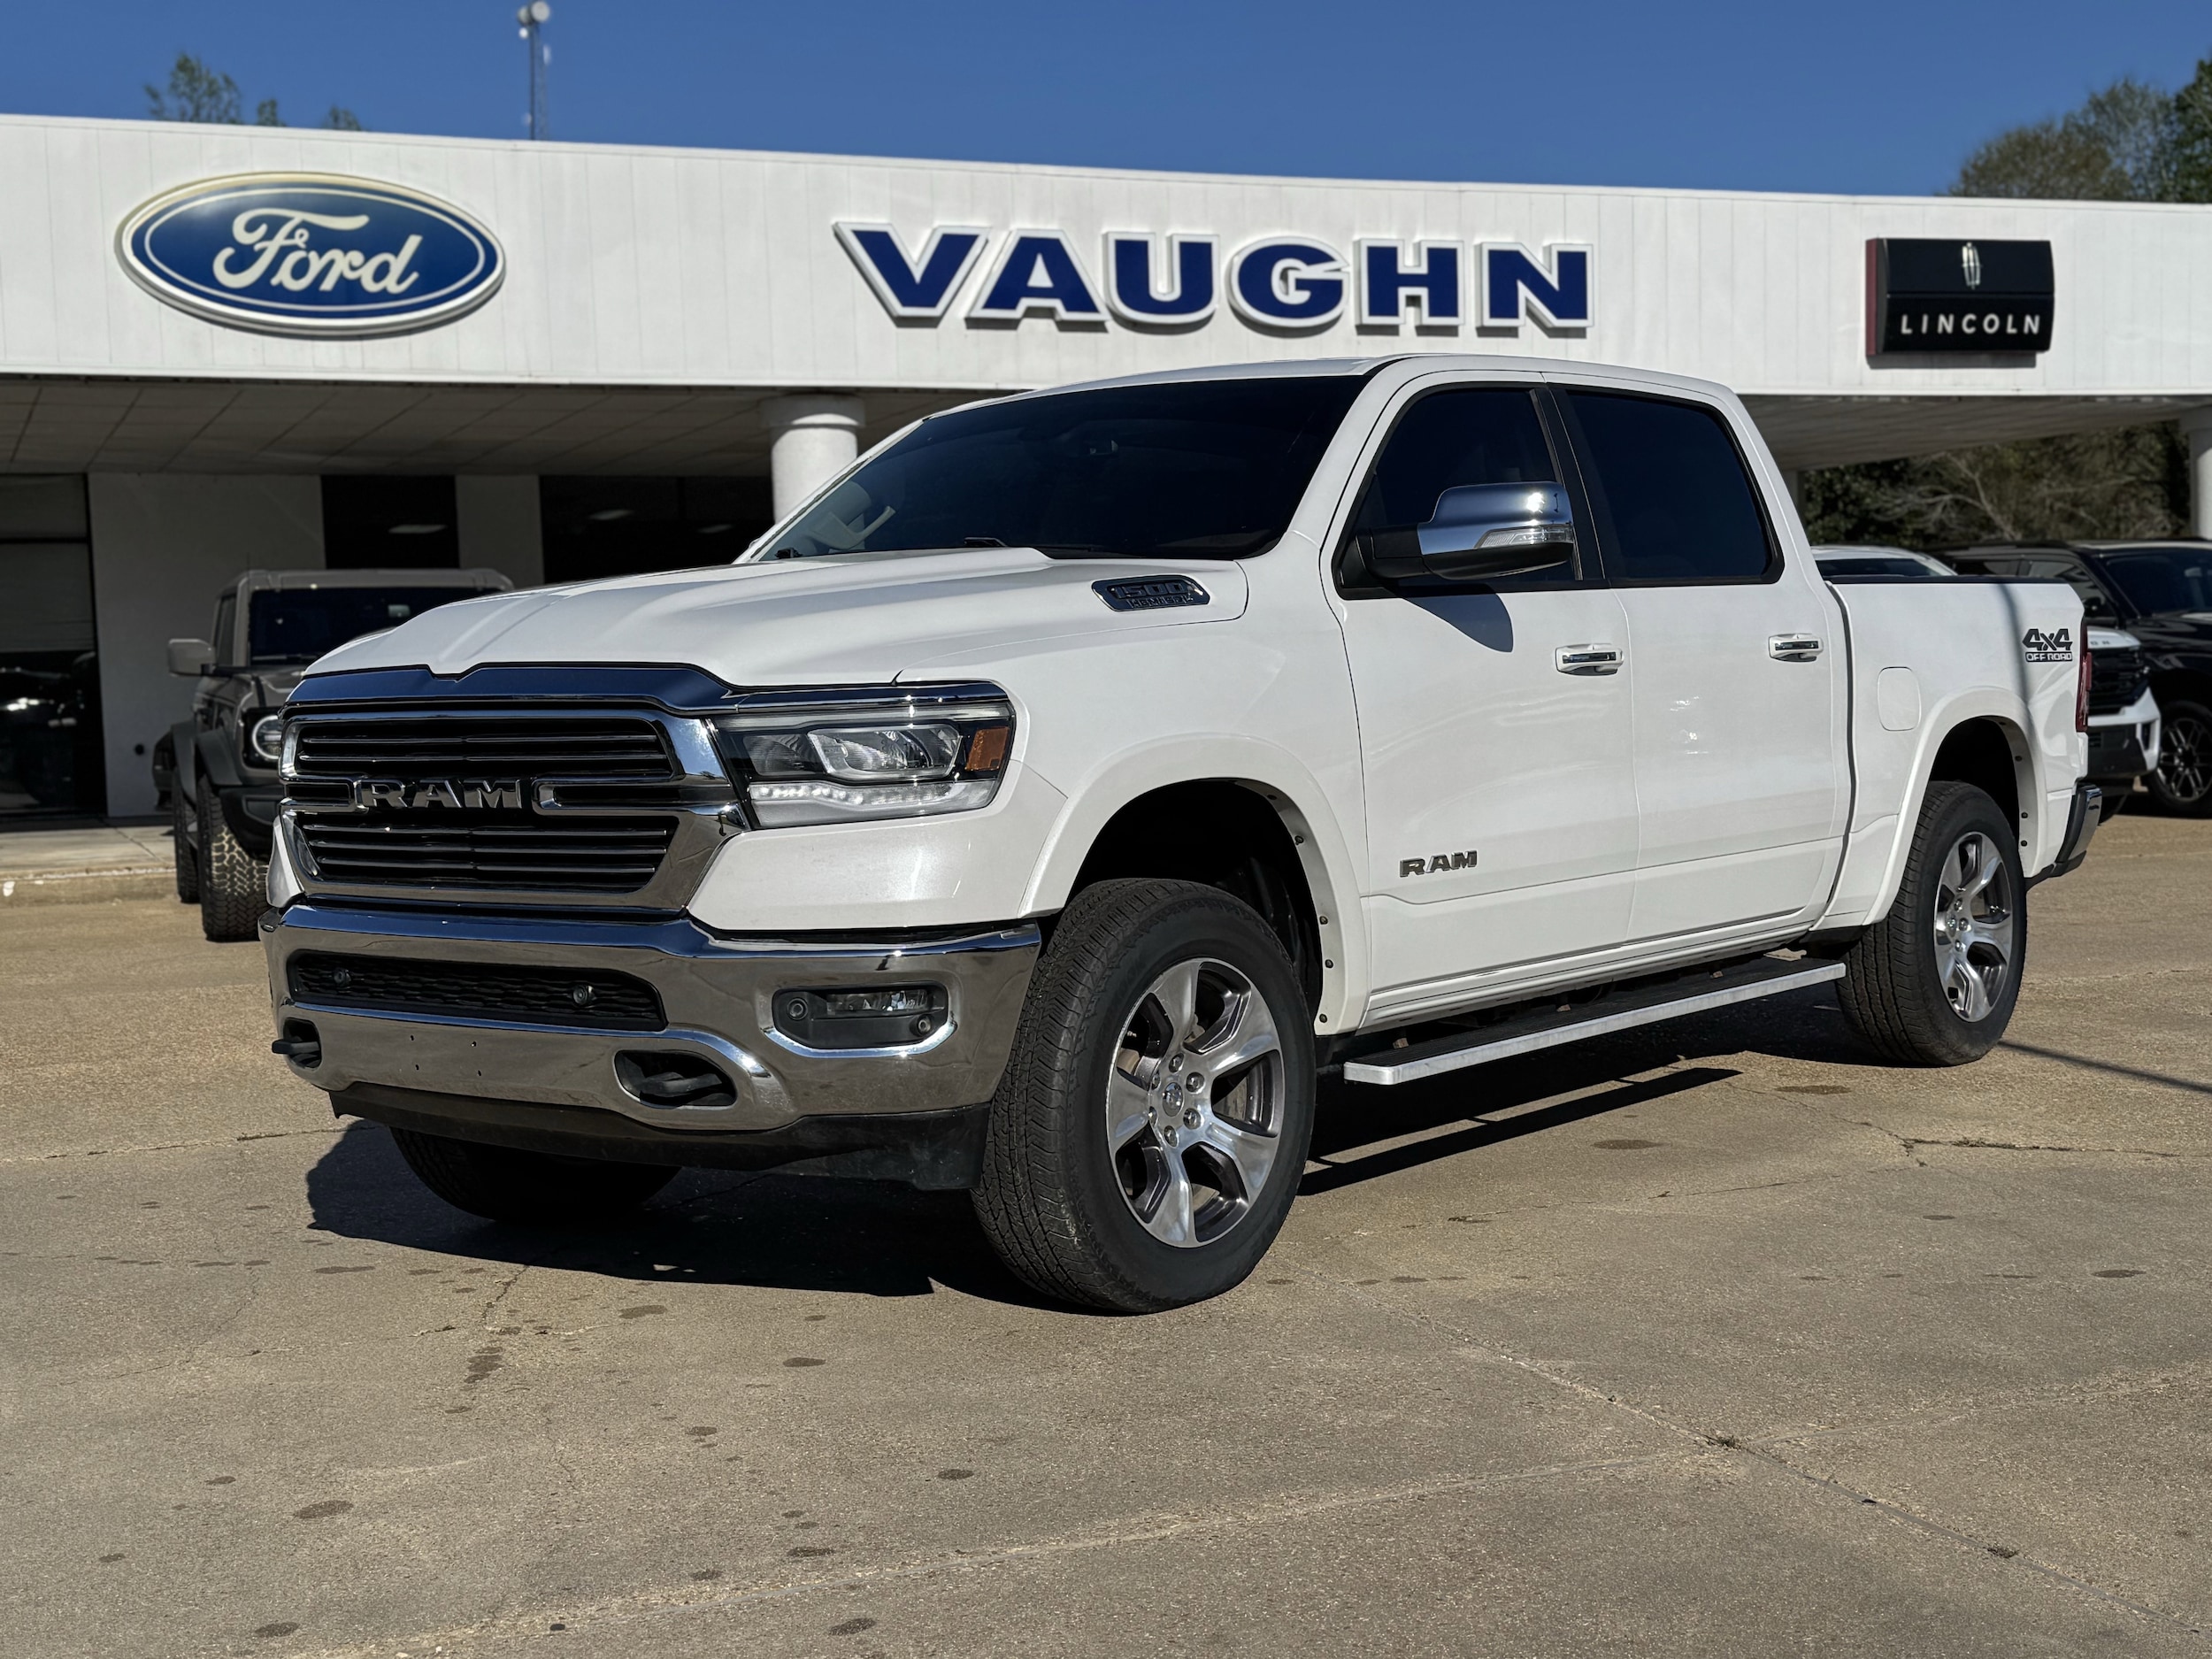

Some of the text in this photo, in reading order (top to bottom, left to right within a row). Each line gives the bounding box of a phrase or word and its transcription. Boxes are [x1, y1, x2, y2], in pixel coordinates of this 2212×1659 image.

[212, 207, 419, 294] Ford
[835, 223, 1594, 329] VAUGHN
[1901, 313, 2040, 334] LINCOLN
[1113, 582, 1190, 598] 1500
[2026, 652, 2072, 661] OFF ROAD
[354, 778, 522, 809] RAM
[1399, 849, 1478, 878] RAM
